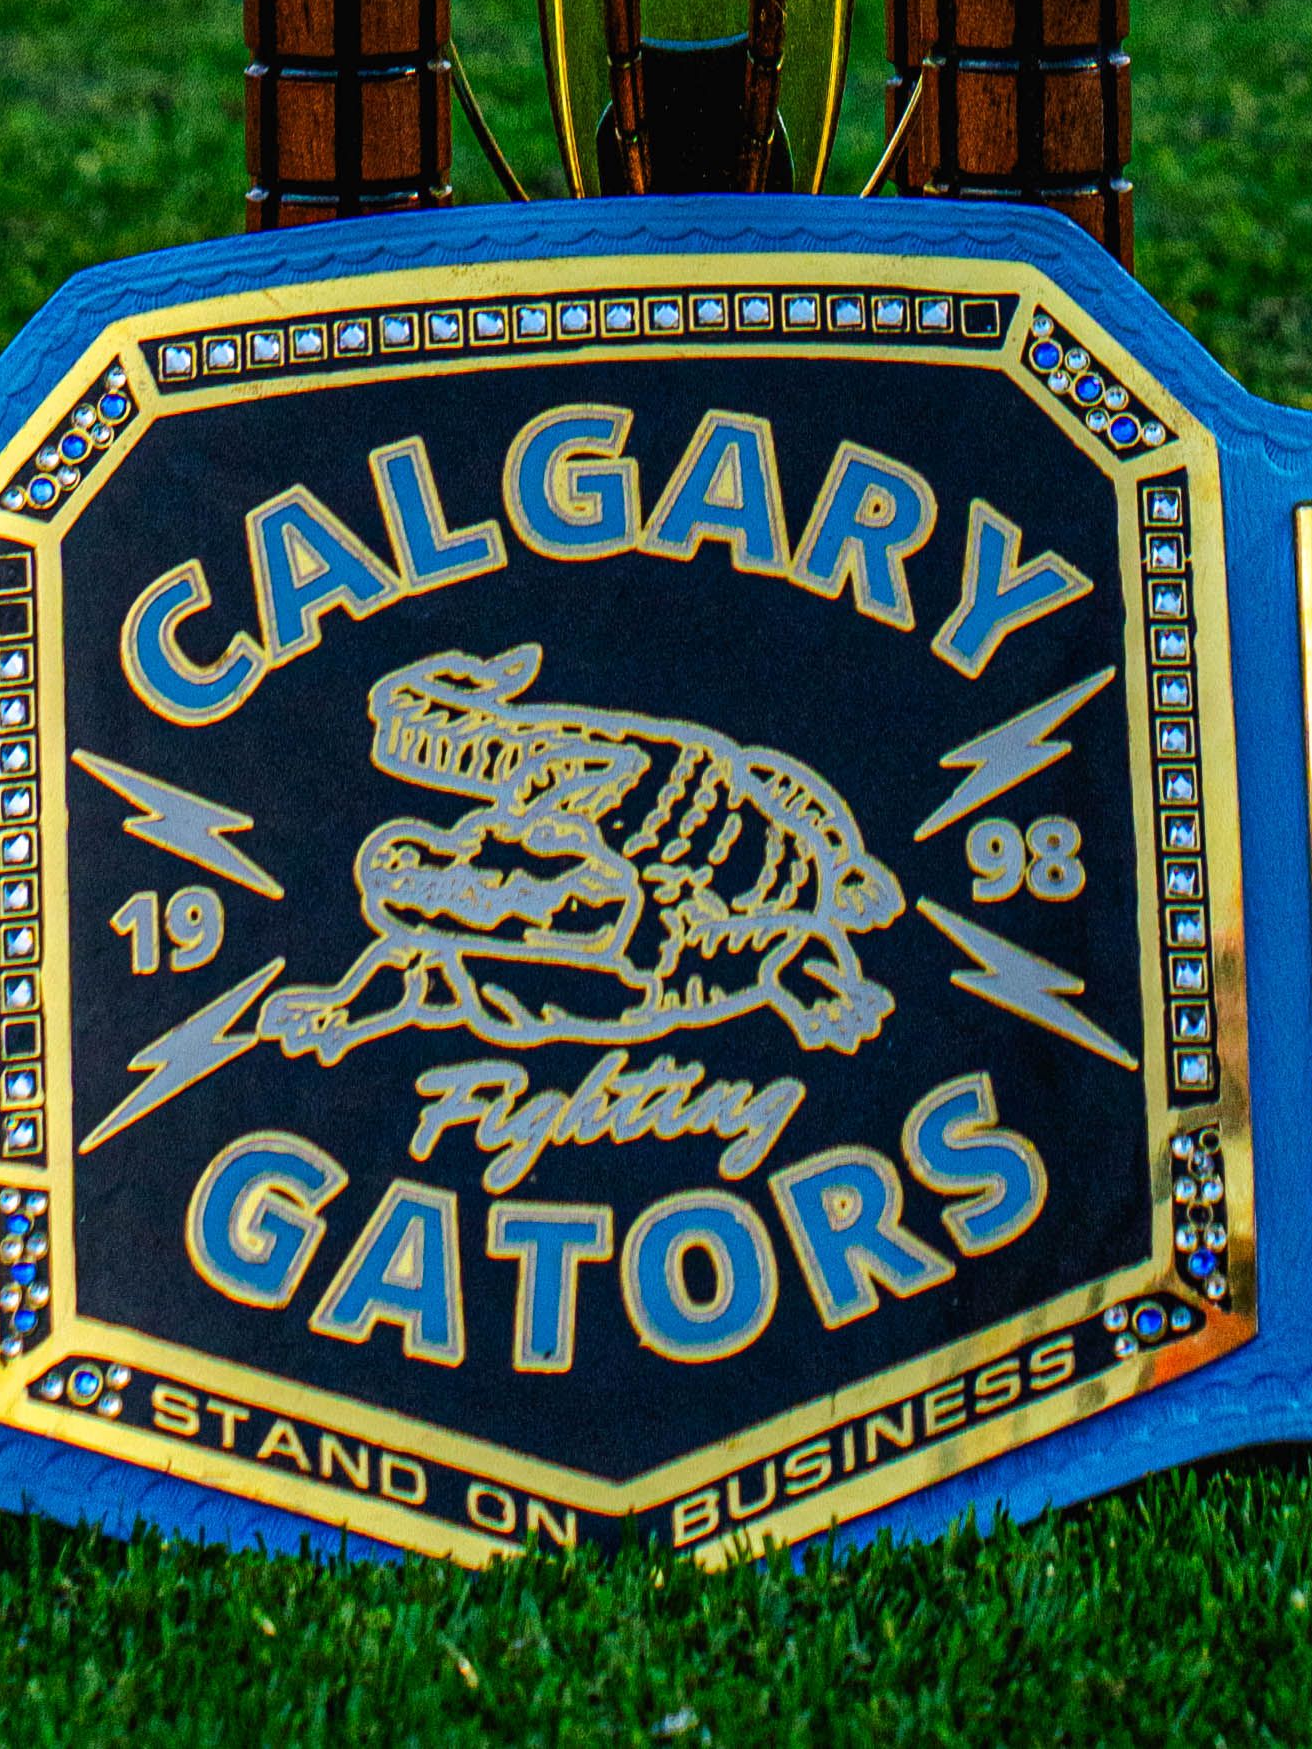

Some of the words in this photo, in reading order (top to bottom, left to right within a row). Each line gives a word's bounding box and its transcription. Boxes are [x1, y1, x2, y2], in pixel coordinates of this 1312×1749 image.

[120, 402, 1094, 726] CALGARY
[110, 886, 226, 974] 19
[965, 816, 1087, 902] 98
[186, 1071, 1049, 1373] GATORS
[408, 1050, 806, 1192] Fighting
[150, 1382, 429, 1506] STAND
[466, 1486, 579, 1549] ON
[671, 1333, 1078, 1549] BUSINESS
